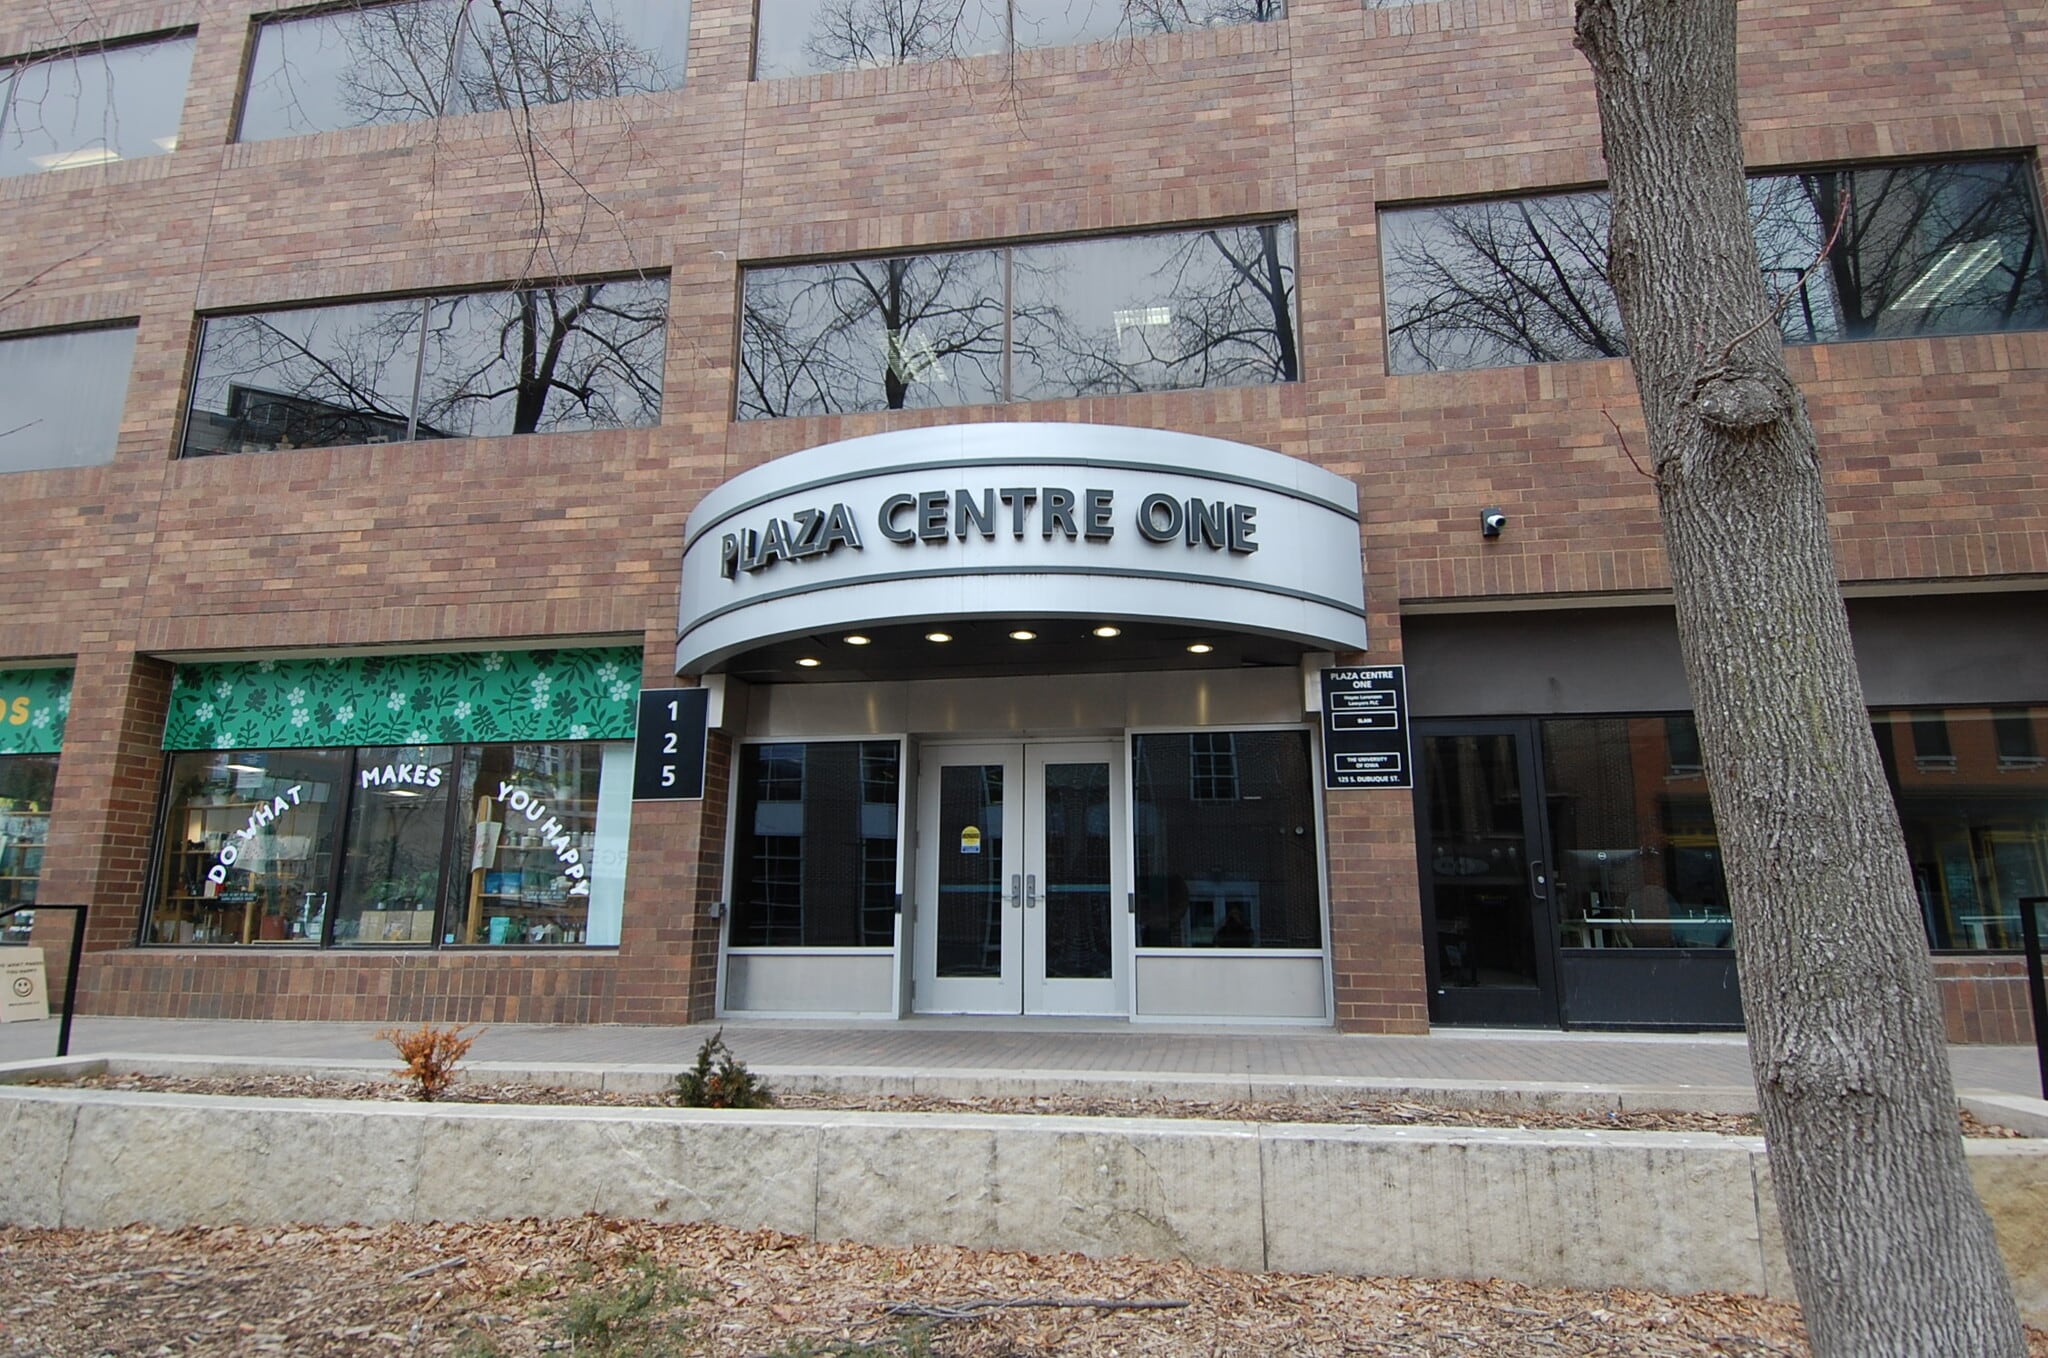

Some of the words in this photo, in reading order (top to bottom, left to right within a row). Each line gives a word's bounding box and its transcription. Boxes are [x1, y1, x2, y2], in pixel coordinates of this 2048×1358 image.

[720, 503, 864, 580] PLAZA
[878, 487, 1115, 543] CENTRE
[1136, 493, 1259, 553] ONE
[1331, 672, 1359, 680] PLAZA
[1360, 671, 1394, 679] CENTRE
[1352, 680, 1372, 689] ONE
[1357, 775, 1389, 783] DUBUQUE
[208, 844, 238, 885] DO
[237, 784, 302, 841] WHAT
[361, 763, 442, 789] MAKES
[497, 781, 546, 822] YOU
[540, 816, 590, 895] HAPPY
